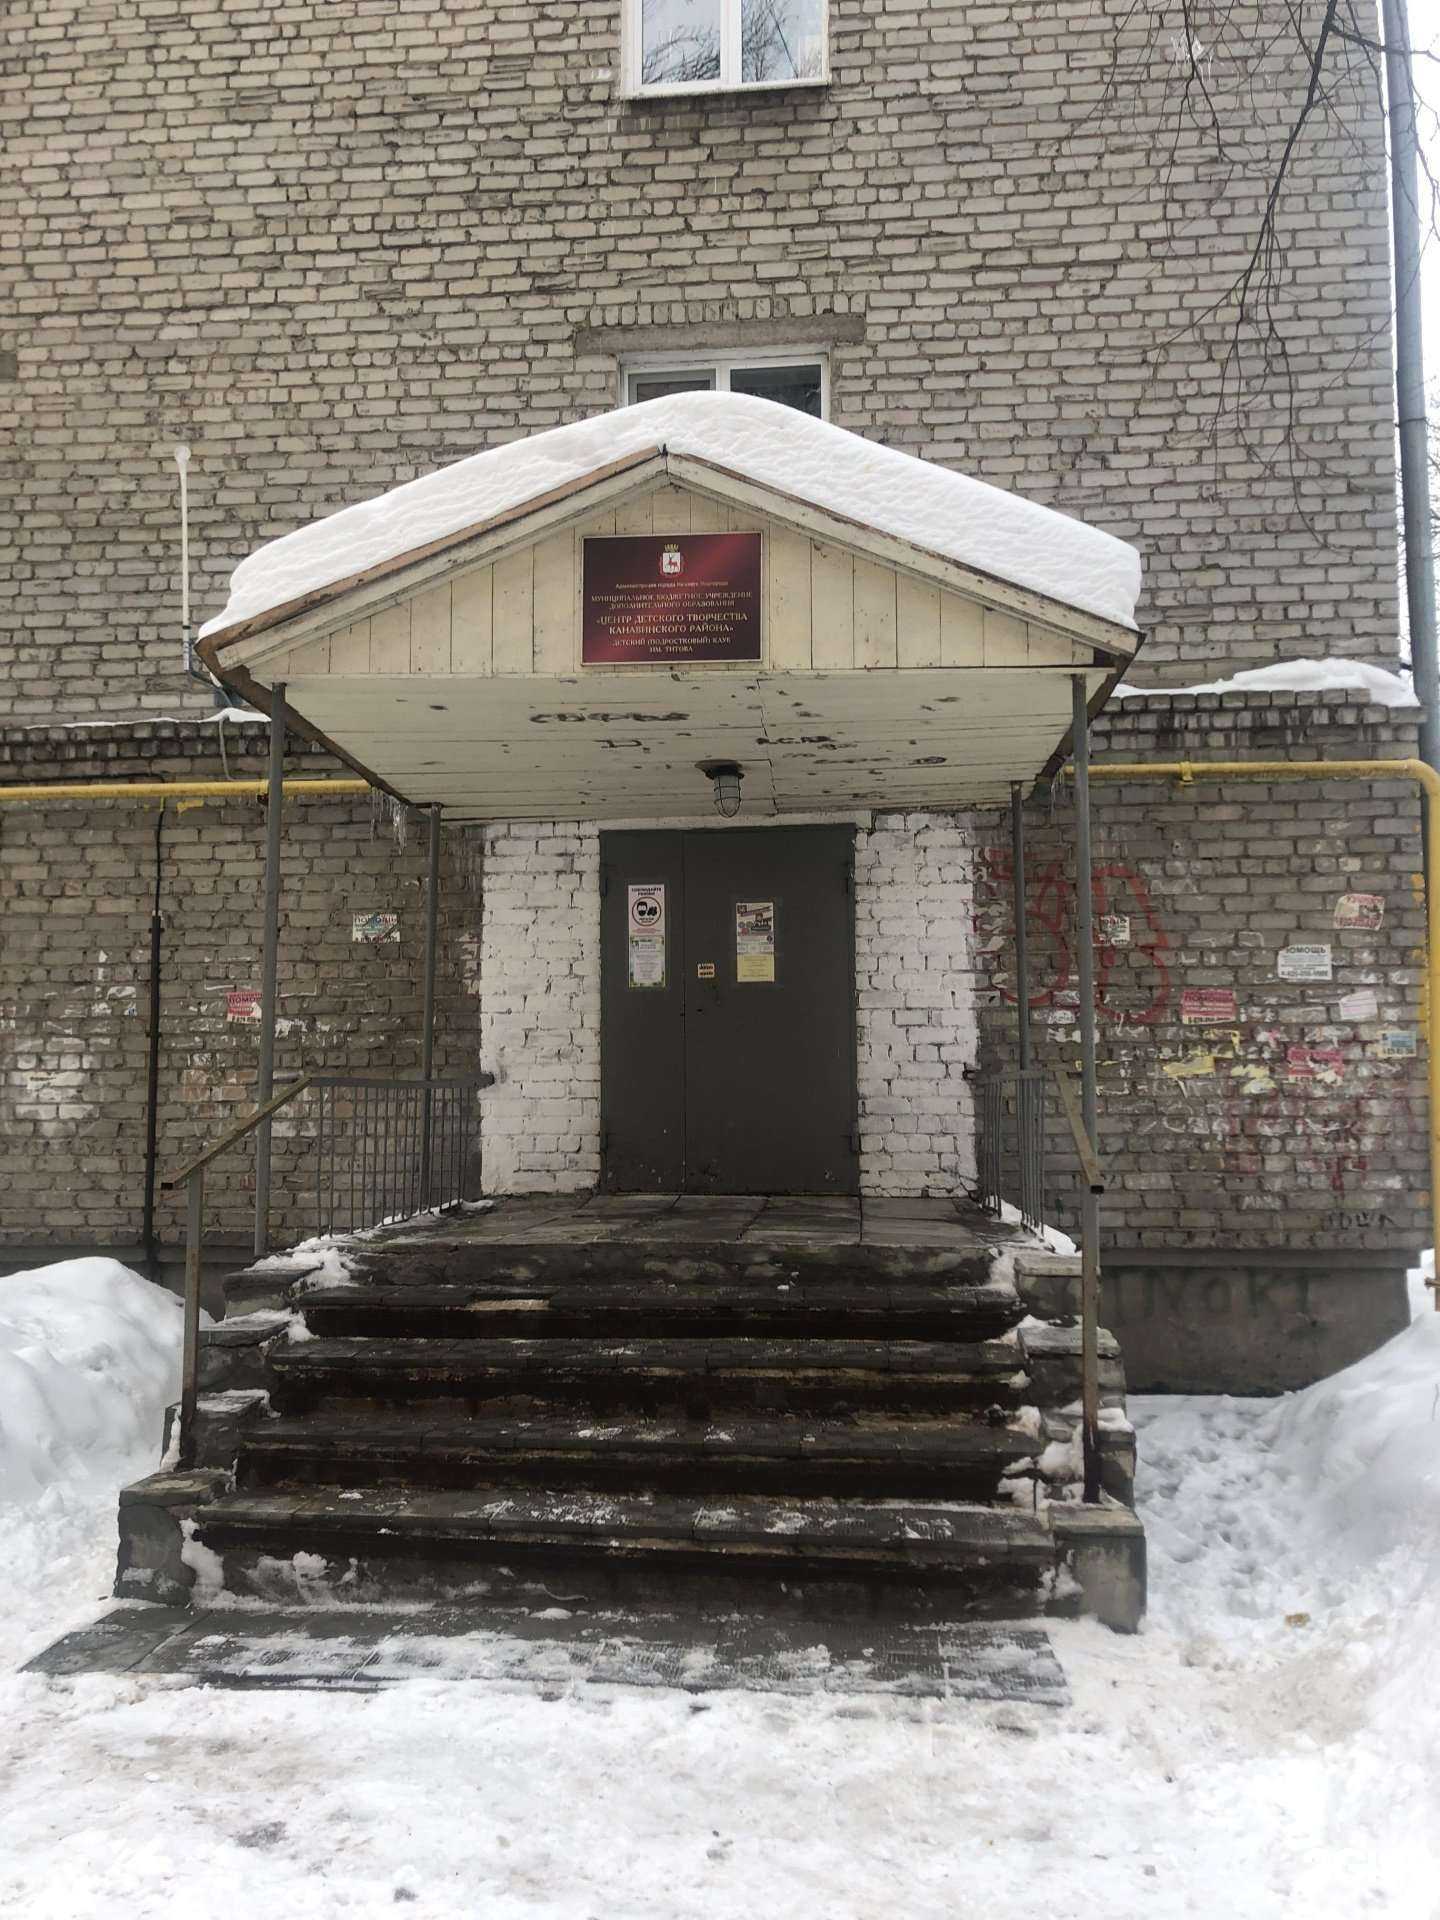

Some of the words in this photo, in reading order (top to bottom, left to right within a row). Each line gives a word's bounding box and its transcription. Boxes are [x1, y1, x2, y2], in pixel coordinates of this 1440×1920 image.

[635, 613, 684, 624] ДЕТСКОГО
[687, 612, 748, 622] ТВОРЧЕСТВА
[609, 625, 687, 635] КАНАВИНСКОГО
